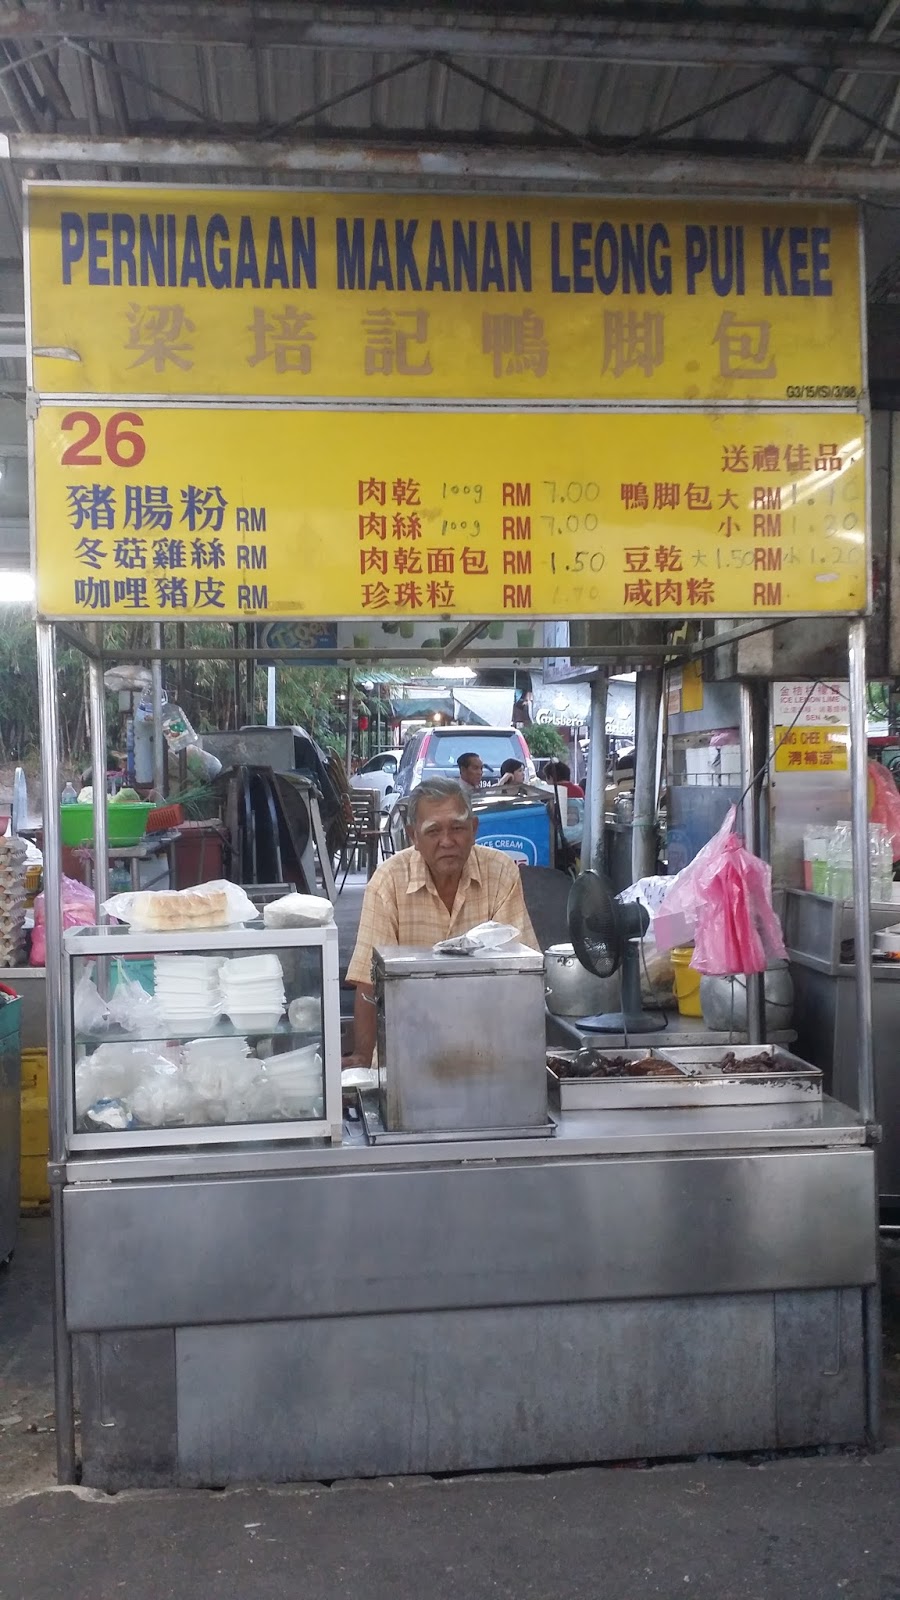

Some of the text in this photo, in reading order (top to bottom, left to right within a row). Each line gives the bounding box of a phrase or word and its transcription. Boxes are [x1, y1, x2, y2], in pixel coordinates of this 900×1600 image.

[60, 211, 833, 298] PERNIAGAAN MAKANAN LEONG PUI KEE
[60, 411, 146, 468] 26
[721, 442, 843, 473] 送禮佳品
[358, 477, 600, 507] 肉乾 100g RM 7.00
[753, 486, 782, 510] RM
[65, 484, 267, 532] 豬腸粉 RM
[358, 511, 598, 540] 肉絲 100g RM 7.00
[718, 516, 740, 538] 小
[753, 513, 782, 537] RM
[74, 537, 267, 570] 冬菇雞絲 RM
[360, 546, 605, 575] 肉乾面包 RM 1.50
[623, 544, 684, 573] 豆乾
[754, 547, 782, 571] RM
[74, 576, 268, 609] 咖哩豬皮 RM
[361, 580, 456, 610] 珍珠粒
[502, 584, 532, 608] RM
[623, 578, 782, 607] 咸肉粽 RM
[495, 840, 524, 850] CREAM
